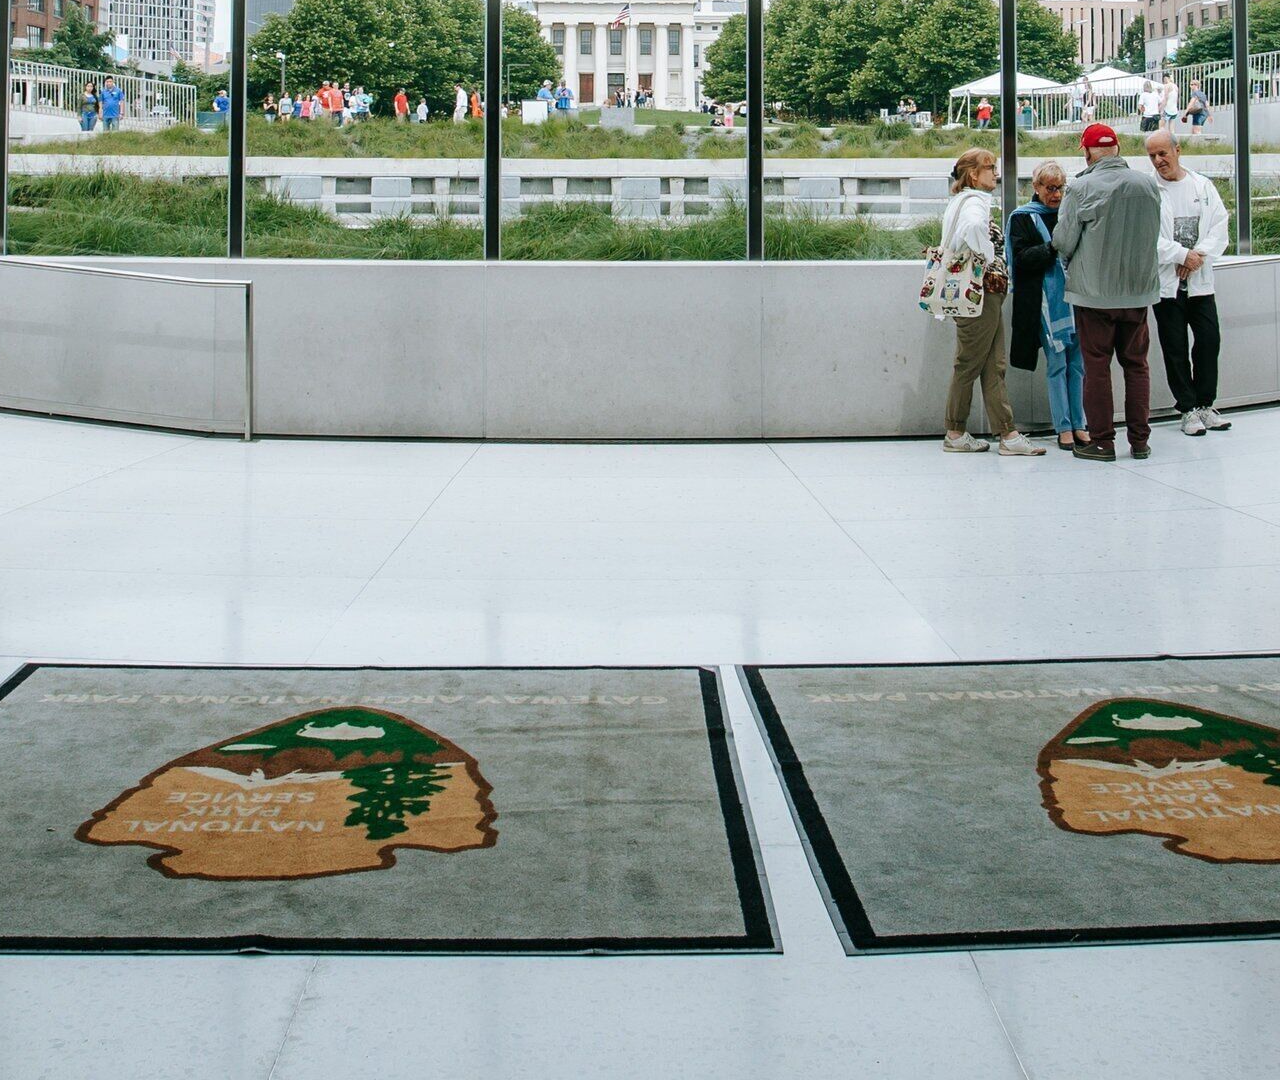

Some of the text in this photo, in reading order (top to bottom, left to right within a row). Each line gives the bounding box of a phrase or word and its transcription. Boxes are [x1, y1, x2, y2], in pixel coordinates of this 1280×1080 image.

[916, 687, 1113, 701] NATIONAL
[1120, 684, 1219, 696] ARCH
[37, 693, 669, 705] GATEWAY ARCH NATIONAL PARK
[806, 691, 908, 704] PARK
[1088, 778, 1235, 795] SERVICE
[167, 791, 317, 804] SERVICE
[1123, 791, 1223, 806] PARK
[179, 804, 283, 818] PARK
[122, 819, 326, 833] NATIONAL
